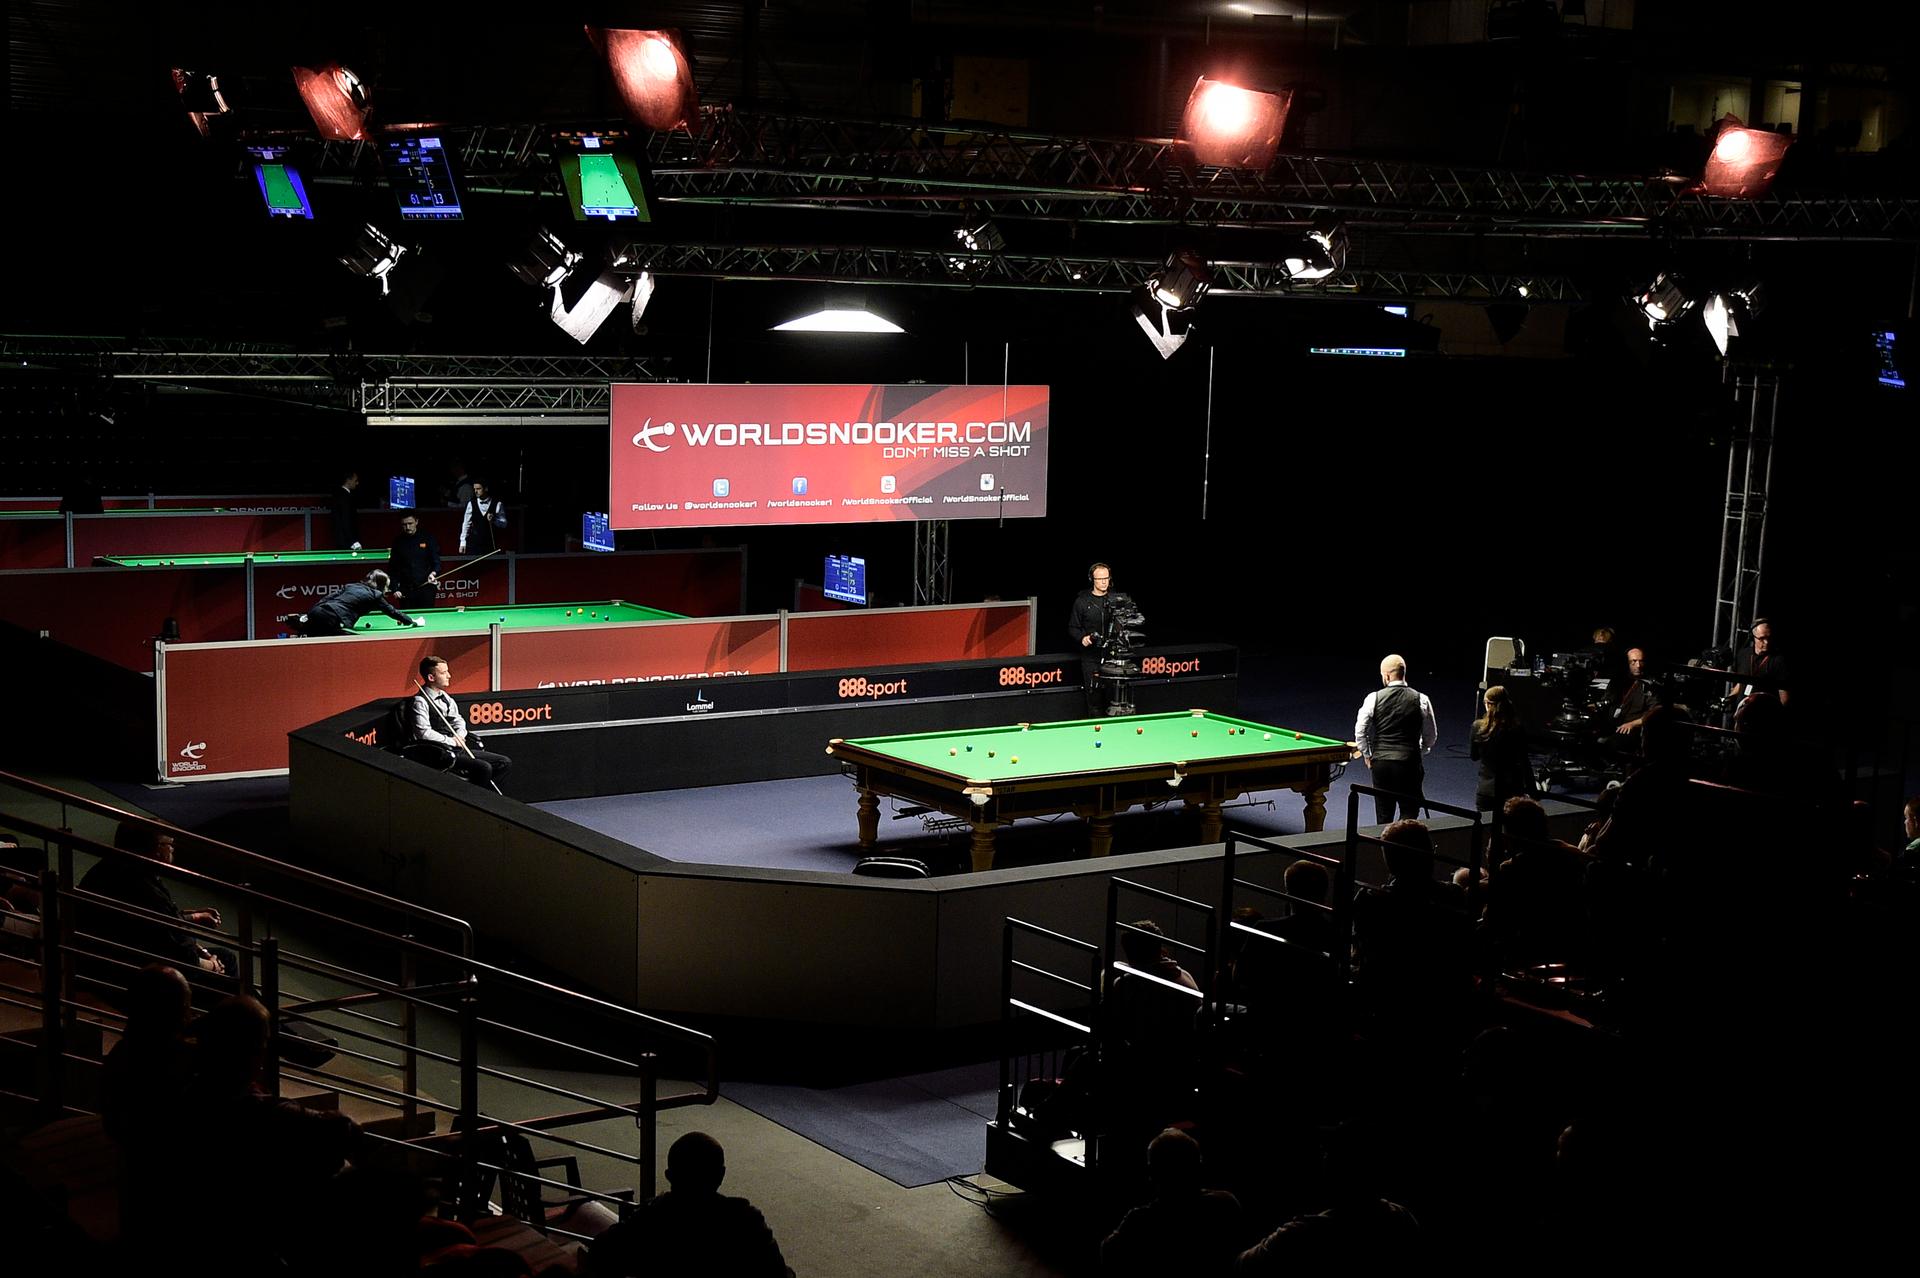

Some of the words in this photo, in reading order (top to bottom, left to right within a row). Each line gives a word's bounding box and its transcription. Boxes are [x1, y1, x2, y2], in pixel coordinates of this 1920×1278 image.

[681, 421, 1031, 446] WORLDSNOOKER.COM
[883, 446, 930, 458] DON'T
[933, 446, 970, 458] MISS
[974, 446, 986, 457] A
[989, 445, 1031, 457] SHOT
[632, 502, 664, 511] Follow
[665, 502, 679, 510] Us
[684, 500, 758, 510] @worldsnooker1
[767, 499, 832, 508] /worldsnooker1
[841, 495, 934, 506] /WorldSnookerOfficial
[999, 666, 1063, 687] 888sport
[1142, 656, 1200, 677] 888sport
[838, 677, 907, 699] 888sport
[469, 701, 552, 726] 888sport
